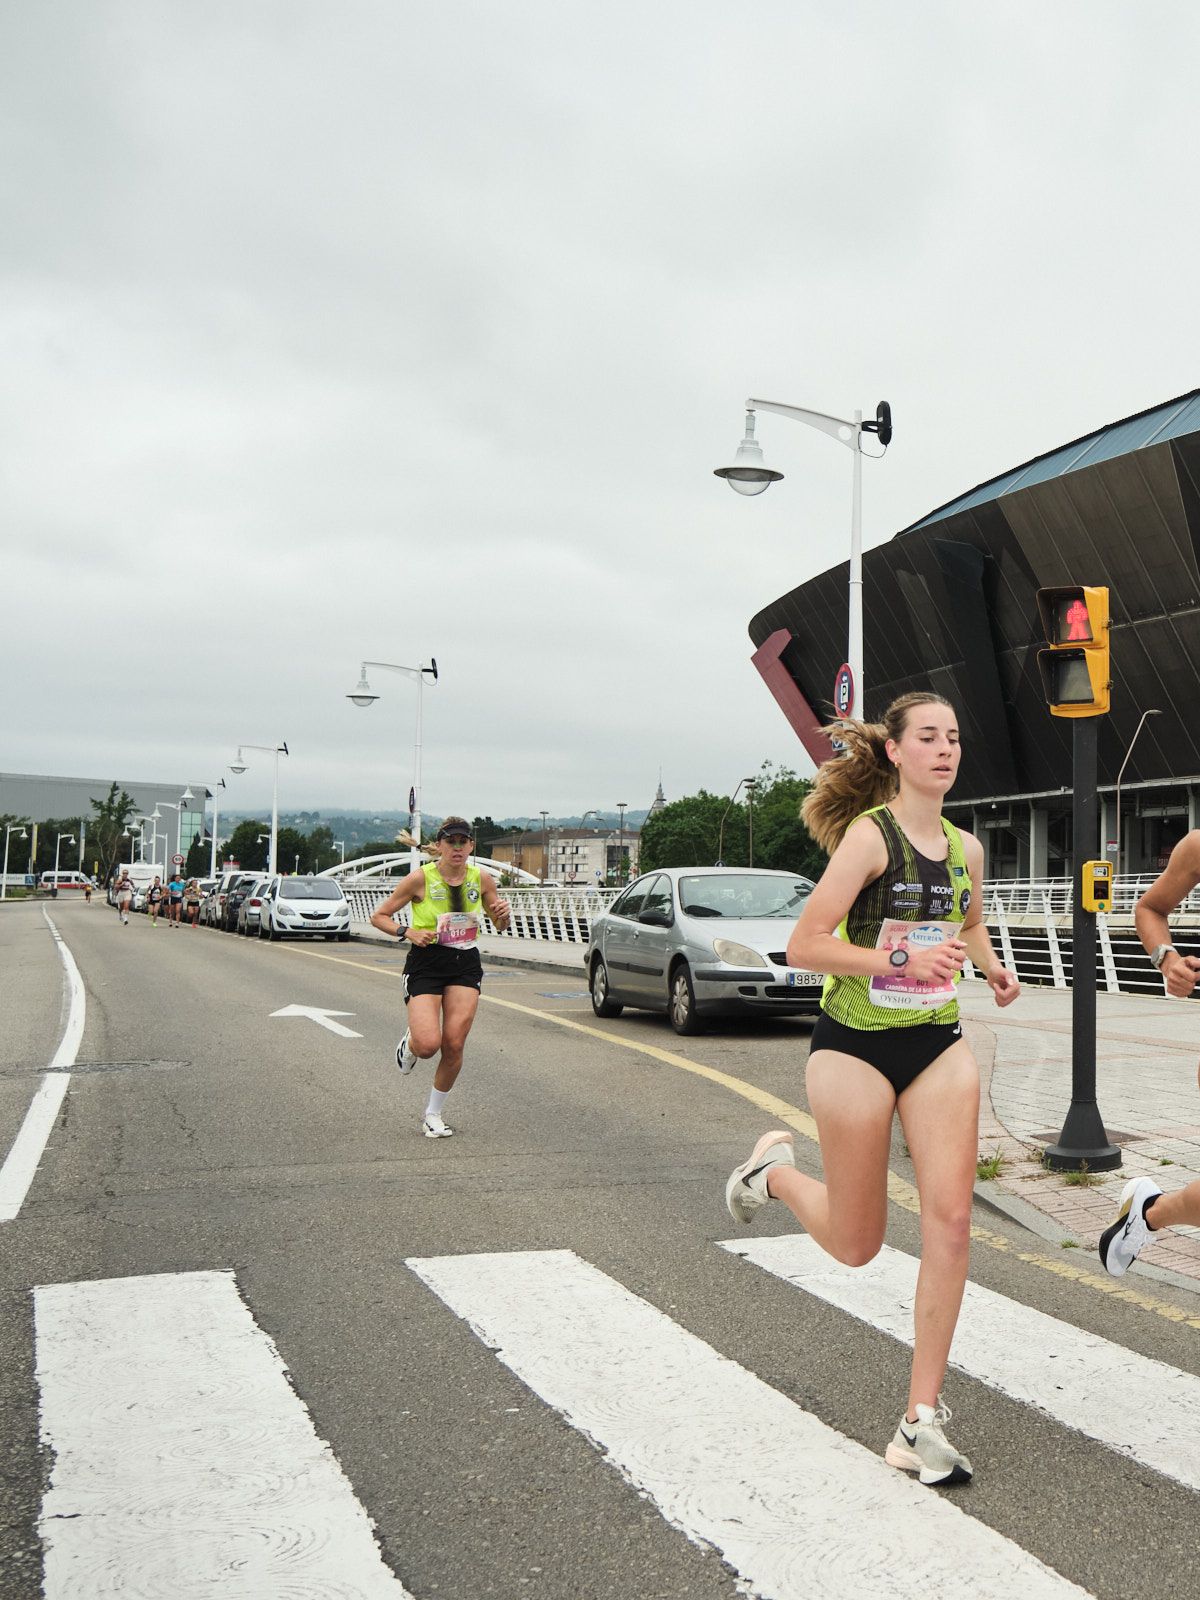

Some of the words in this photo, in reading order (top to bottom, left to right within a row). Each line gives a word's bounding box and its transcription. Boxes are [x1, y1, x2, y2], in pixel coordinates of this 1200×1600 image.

[450, 929, 466, 938] 016
[796, 974, 824, 984] 9857
[881, 994, 912, 1004] OYSHO
